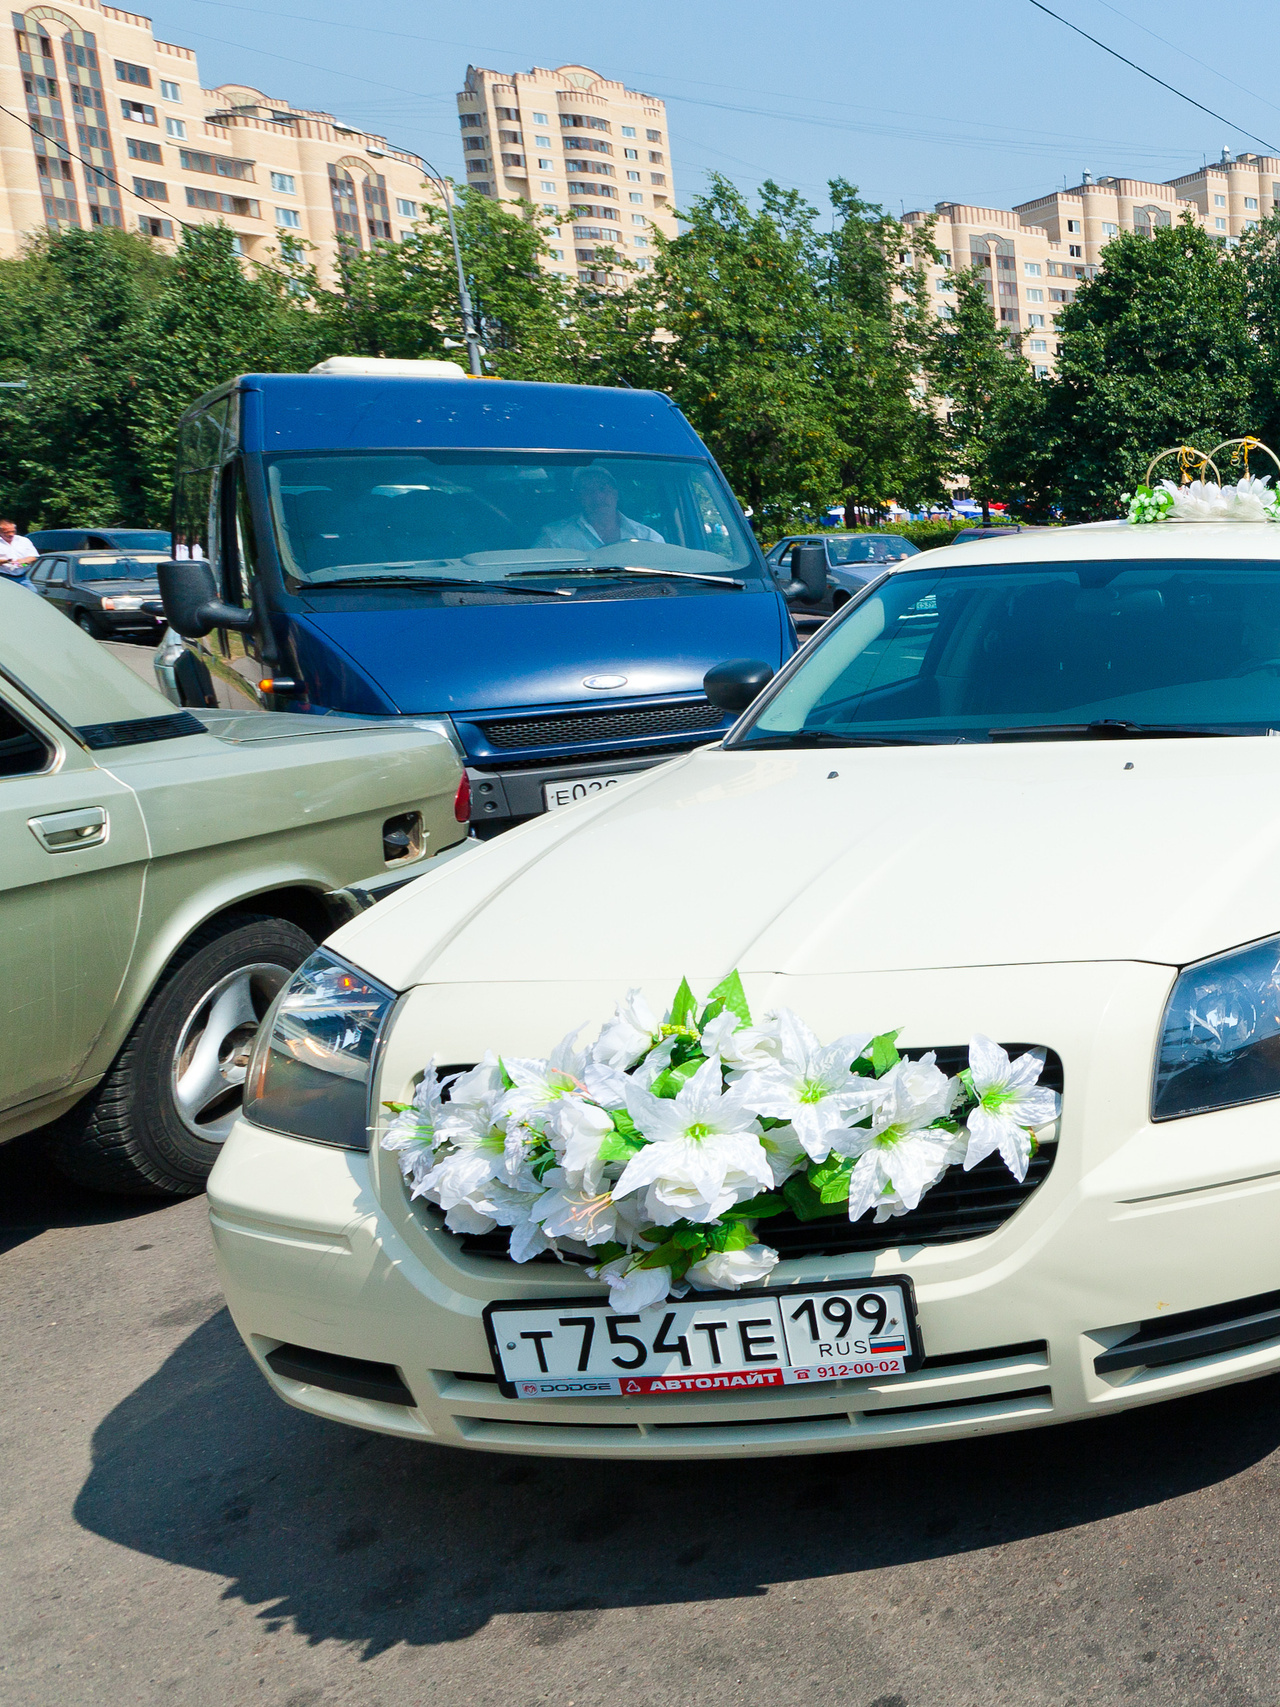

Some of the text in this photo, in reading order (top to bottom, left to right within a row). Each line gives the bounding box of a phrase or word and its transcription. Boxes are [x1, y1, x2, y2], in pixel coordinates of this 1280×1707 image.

[791, 1293, 887, 1341] 199
[819, 1340, 868, 1357] RUS
[540, 1382, 612, 1393] DODGE
[650, 1360, 900, 1392] АВТОЛАЙТ 912-00-02
